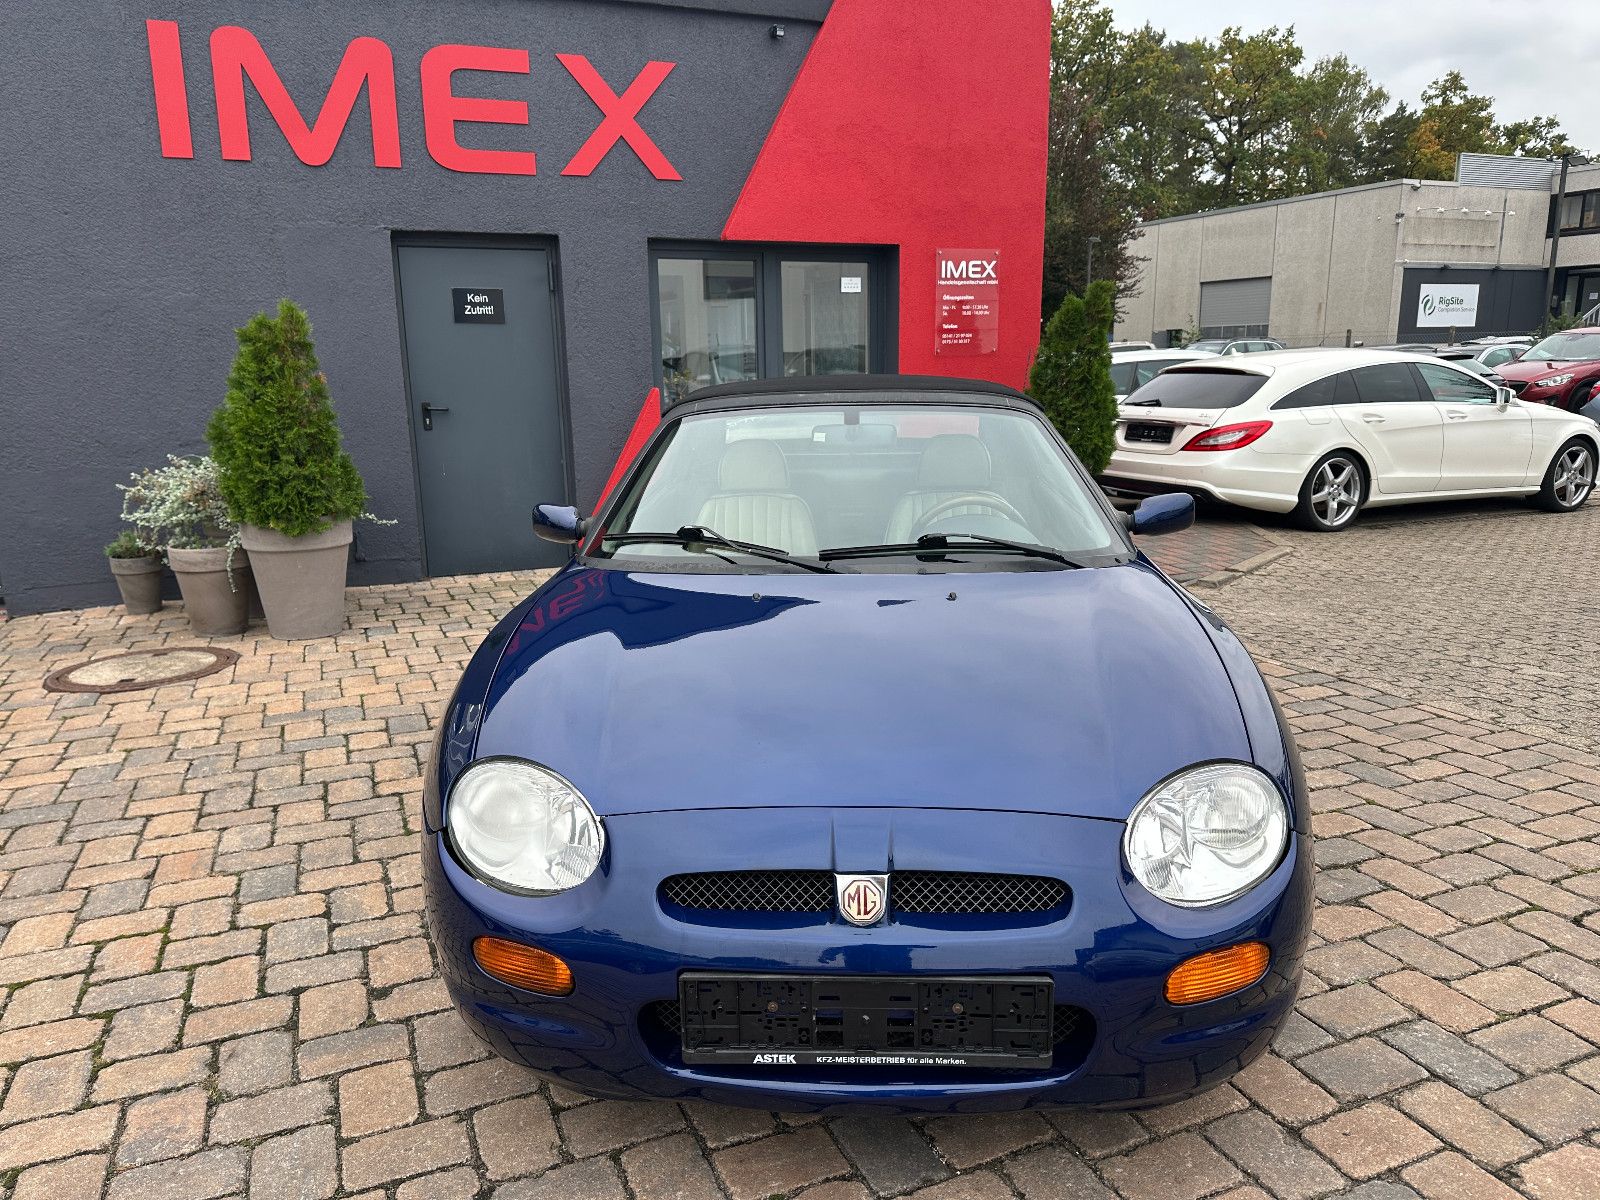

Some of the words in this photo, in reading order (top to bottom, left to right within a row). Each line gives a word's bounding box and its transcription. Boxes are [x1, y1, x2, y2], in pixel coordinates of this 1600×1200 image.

[146, 19, 683, 181] IMEX
[942, 260, 996, 278] IMEX
[467, 293, 489, 303] Kein
[1439, 296, 1464, 307] RigSite
[464, 305, 494, 315] Zutritt!
[847, 884, 877, 916] MG
[752, 1053, 797, 1064] ASTEK
[816, 1056, 906, 1064] KFZ-MEISTERBETRIEB
[935, 1057, 967, 1065] Marken.
